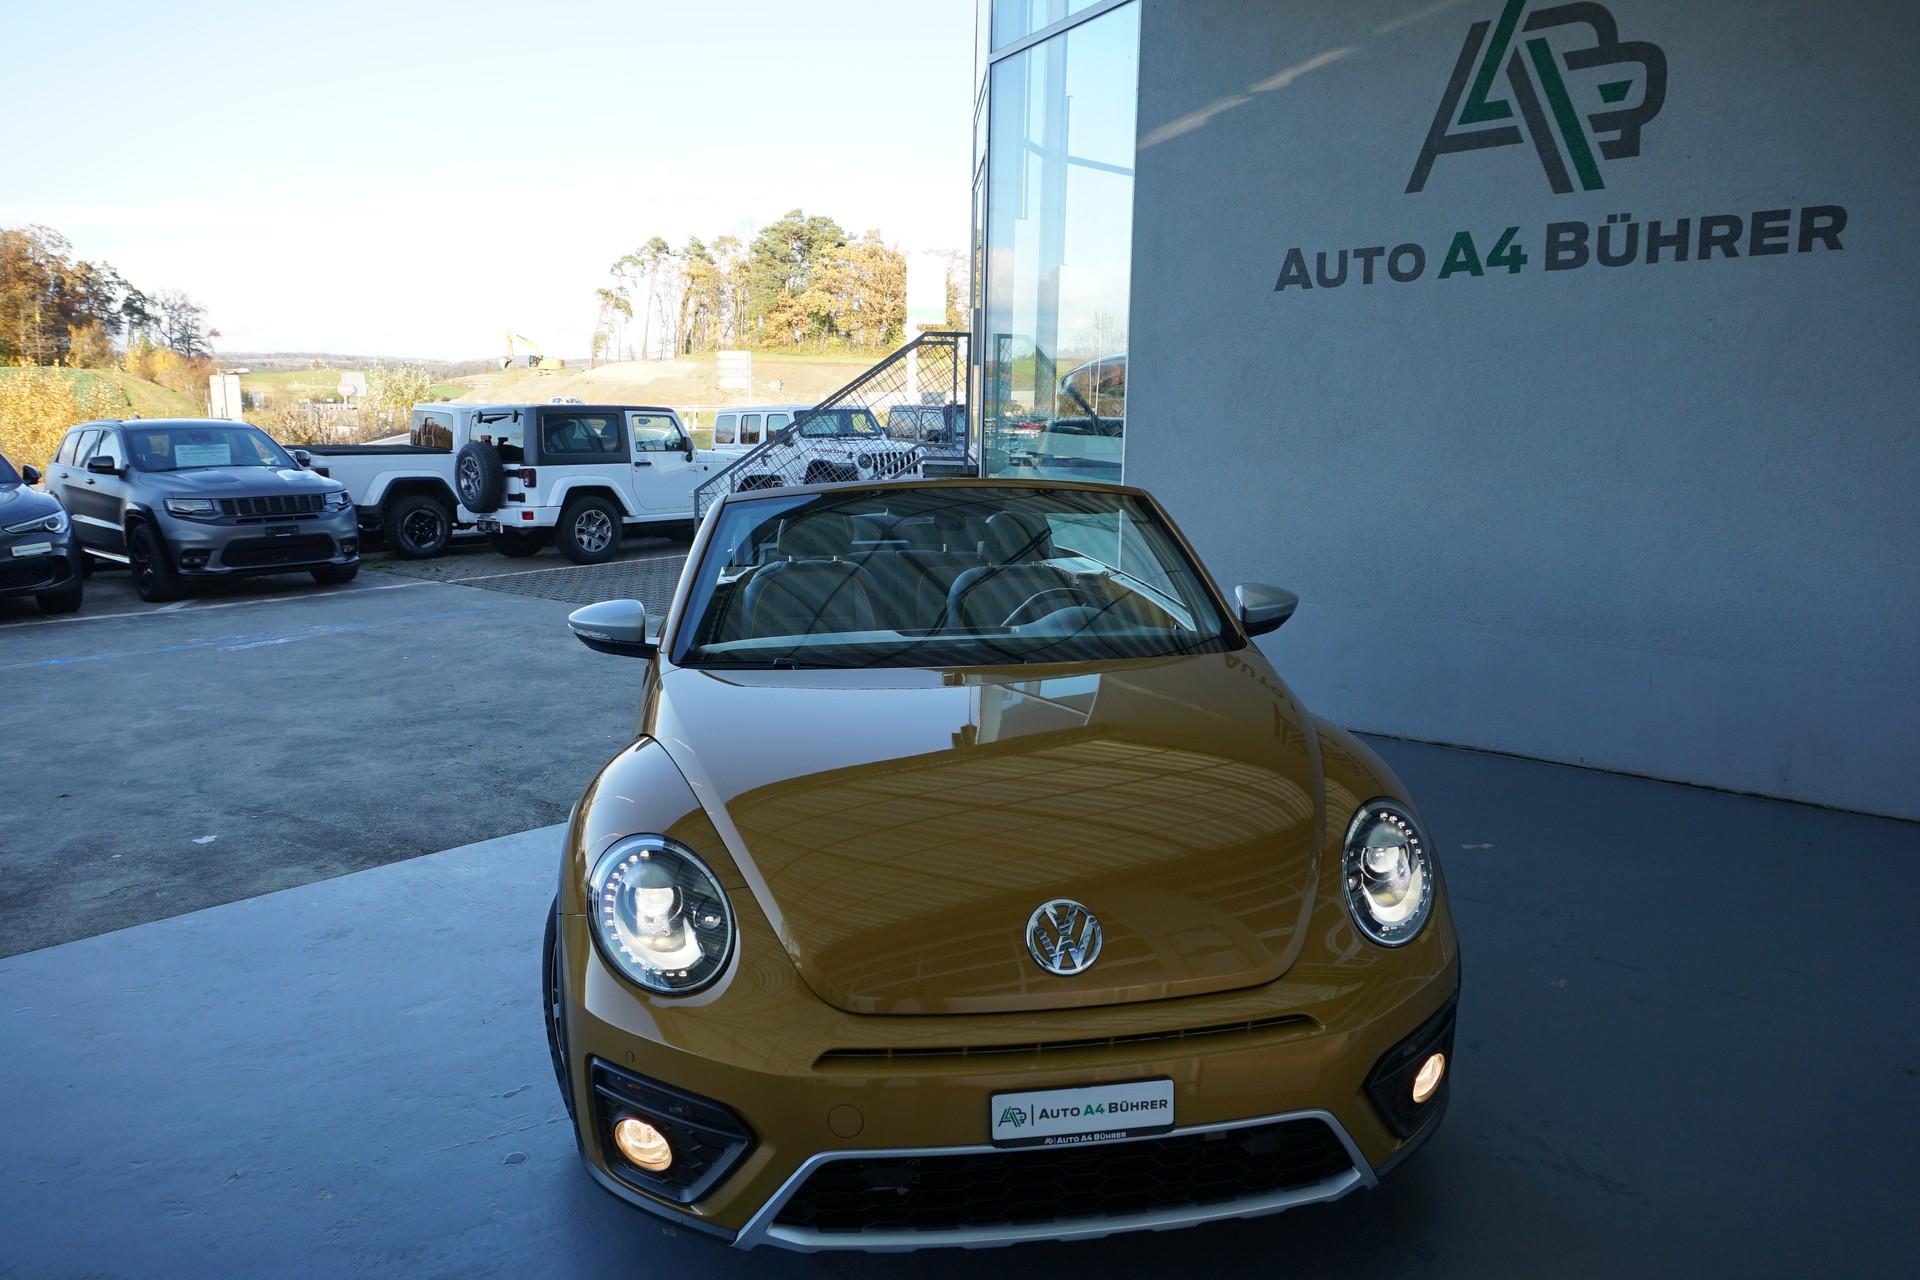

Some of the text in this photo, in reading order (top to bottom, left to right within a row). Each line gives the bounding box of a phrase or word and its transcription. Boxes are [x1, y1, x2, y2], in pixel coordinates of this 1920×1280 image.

[1273, 204, 1849, 292] AUTO A4 BÜHRER
[1025, 898, 1103, 976] VW
[1038, 1107, 1081, 1120] AUTO
[1083, 1103, 1105, 1116] A4
[1108, 1099, 1168, 1114] BÜHRER
[1056, 1136, 1080, 1144] AUTO
[1080, 1134, 1093, 1142] A4
[1093, 1131, 1127, 1141] BÜHRER
